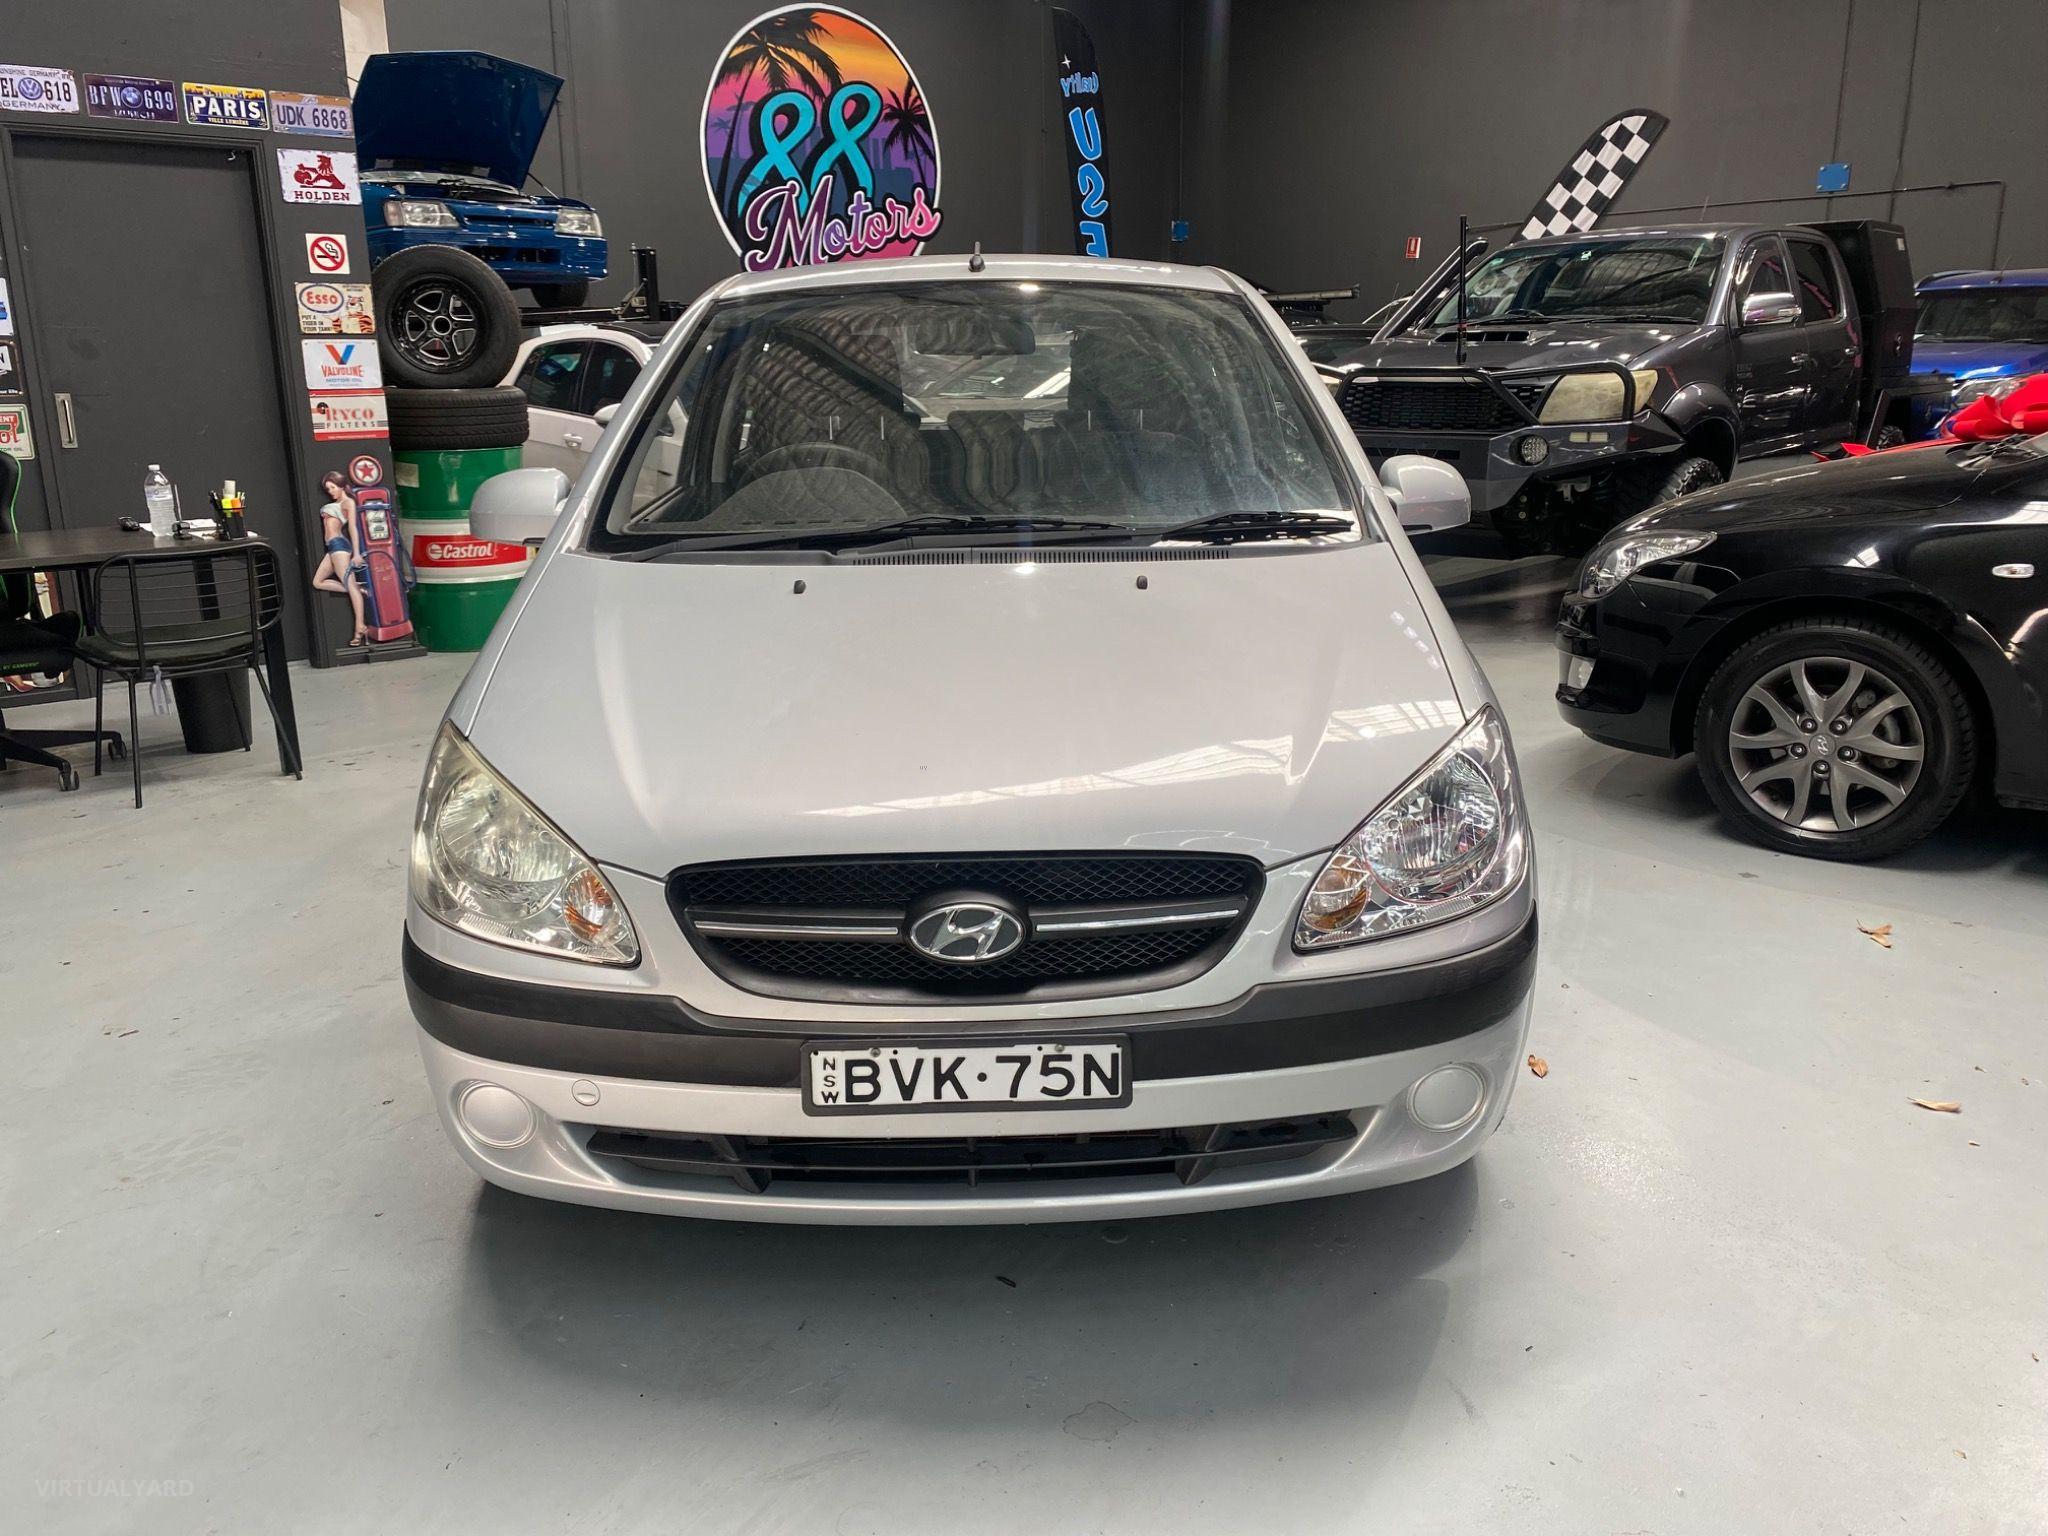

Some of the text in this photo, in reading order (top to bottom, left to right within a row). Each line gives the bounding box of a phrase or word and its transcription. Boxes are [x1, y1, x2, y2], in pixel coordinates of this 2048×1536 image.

[44, 81, 72, 102] 618
[143, 89, 174, 110] 699
[3, 100, 60, 110] GERMANY
[192, 96, 261, 119] PARIS
[277, 105, 348, 130] UDK 6868
[737, 84, 882, 217] 88
[294, 190, 350, 201] HOLDEN
[744, 174, 942, 272] Motors
[321, 364, 364, 377] VALVOLINE
[325, 407, 374, 421] RYCO
[443, 542, 493, 559] Castrol
[821, 1058, 840, 1103] NSW
